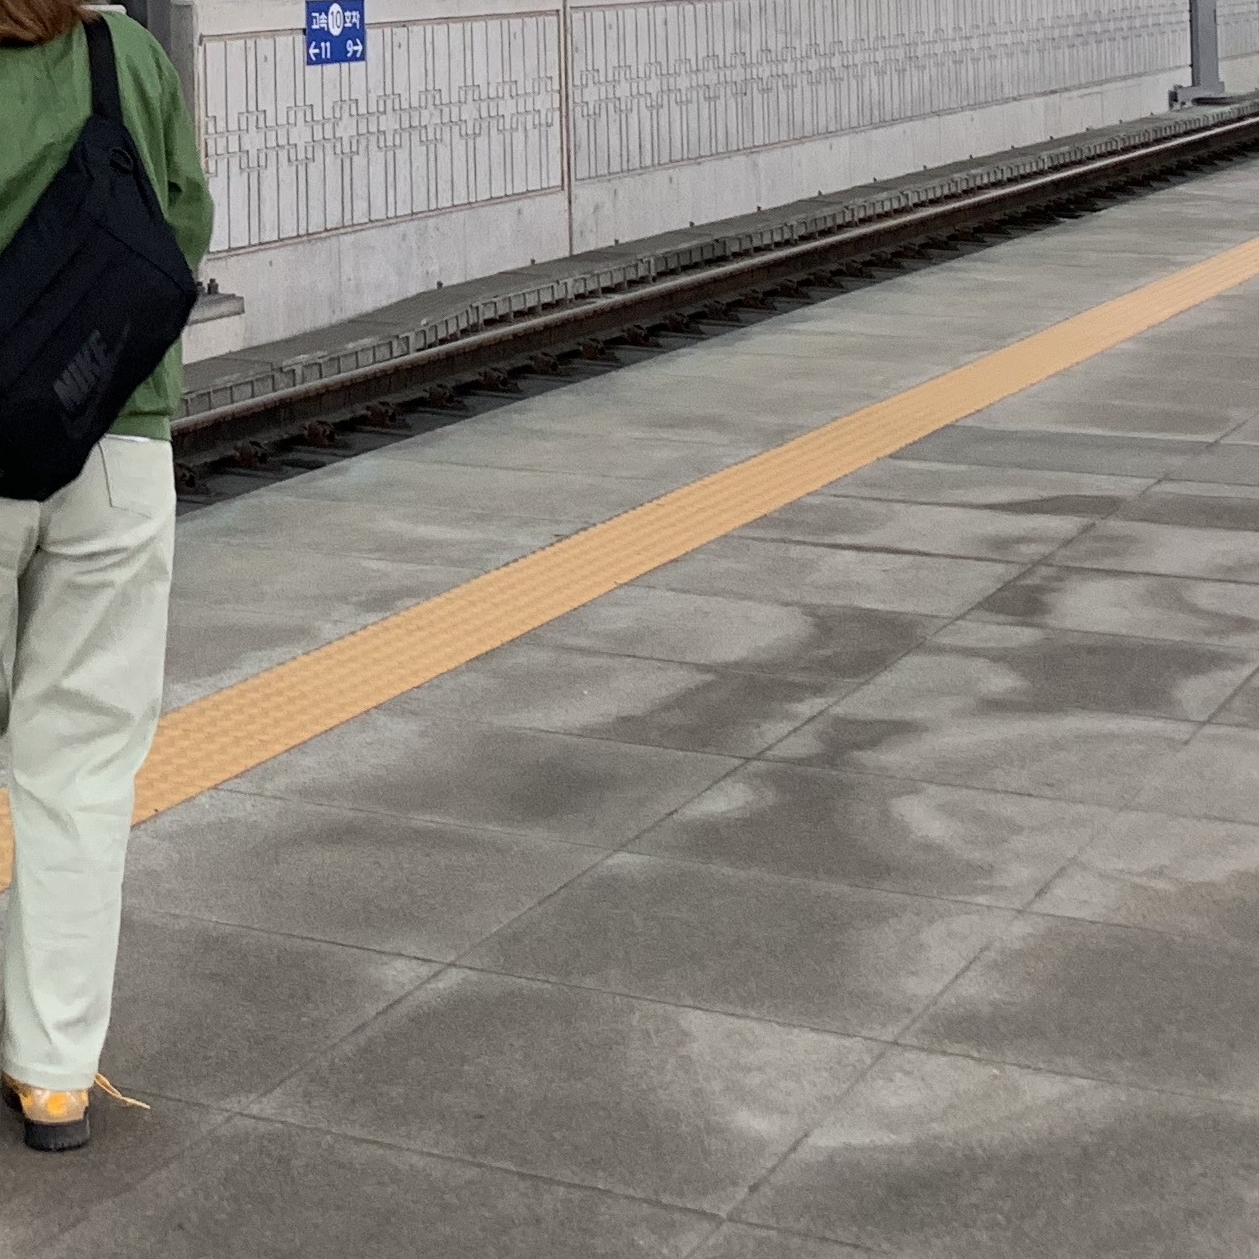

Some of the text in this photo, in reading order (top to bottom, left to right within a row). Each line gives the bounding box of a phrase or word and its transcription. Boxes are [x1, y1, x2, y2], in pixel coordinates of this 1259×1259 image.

[311, 10, 360, 31] 고속 10 호차
[321, 39, 354, 59] 11 9
[53, 330, 113, 410] NIKE
